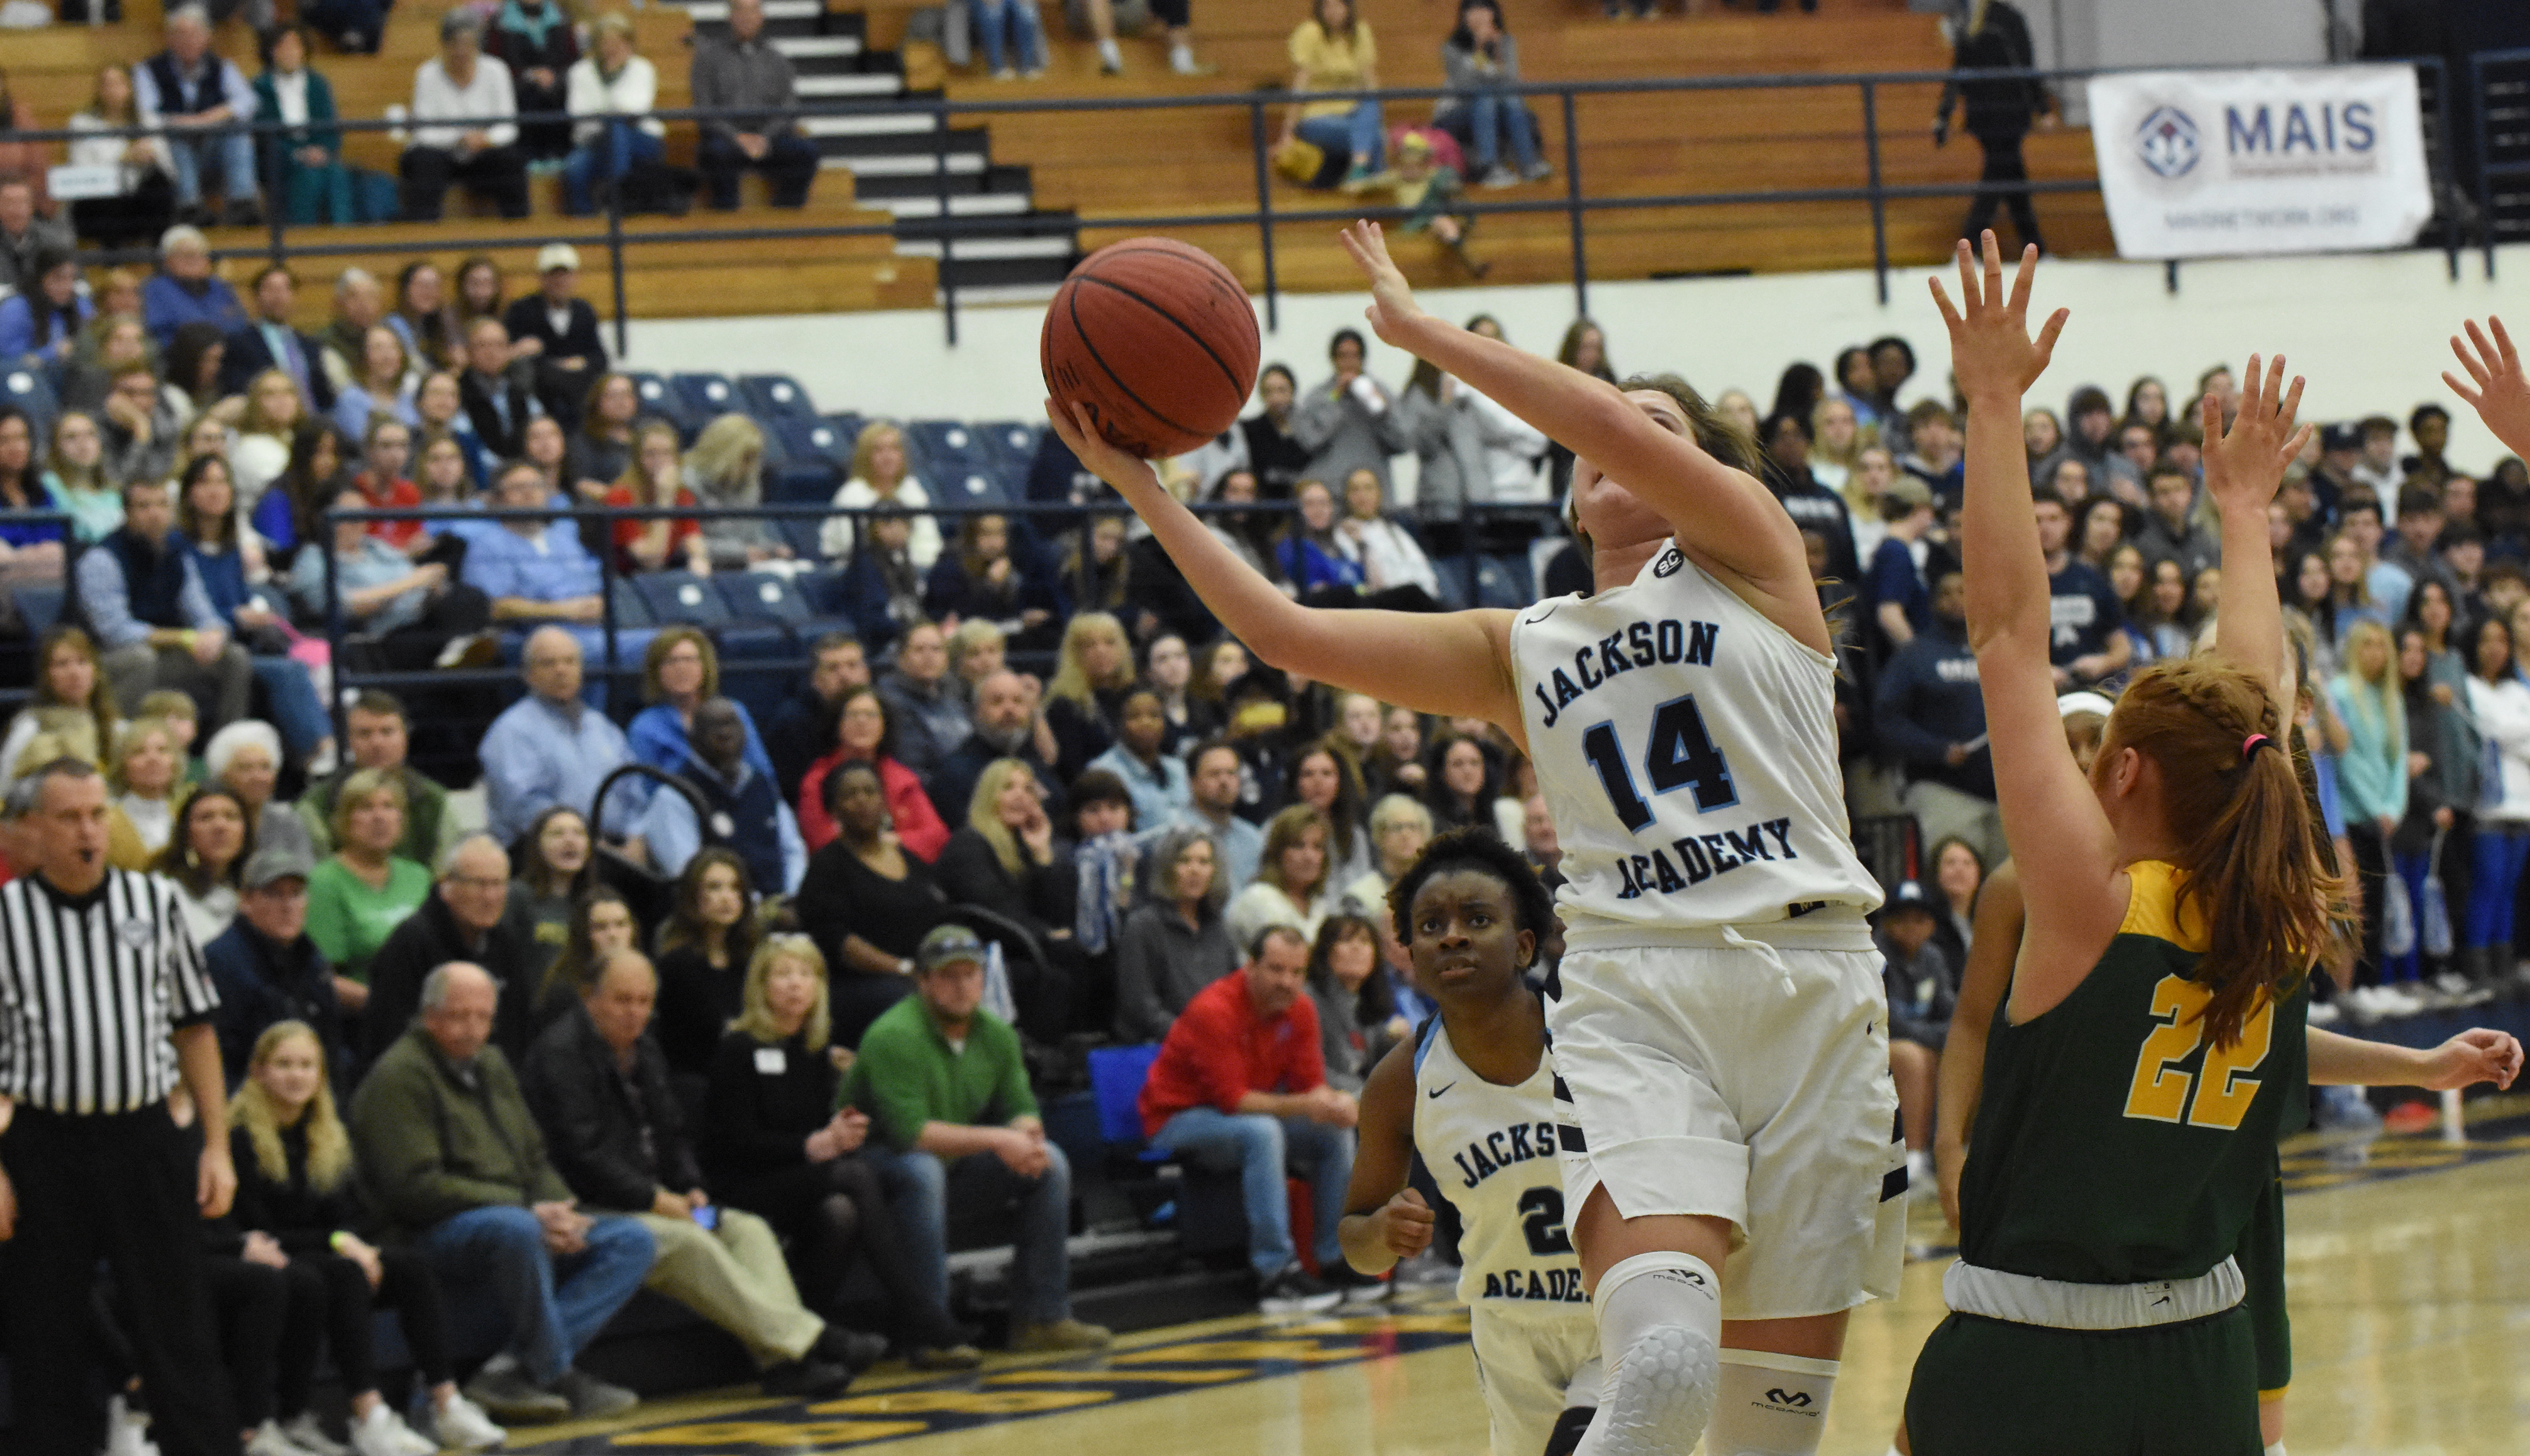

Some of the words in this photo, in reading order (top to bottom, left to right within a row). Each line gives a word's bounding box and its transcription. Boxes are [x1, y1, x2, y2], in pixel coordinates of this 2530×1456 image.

[2225, 102, 2376, 152] MAIS
[1535, 619, 1719, 728] JACKSON
[1582, 693, 1740, 834] 14
[1616, 817, 1798, 898] ACADEMY
[2123, 973, 2274, 1130] 22
